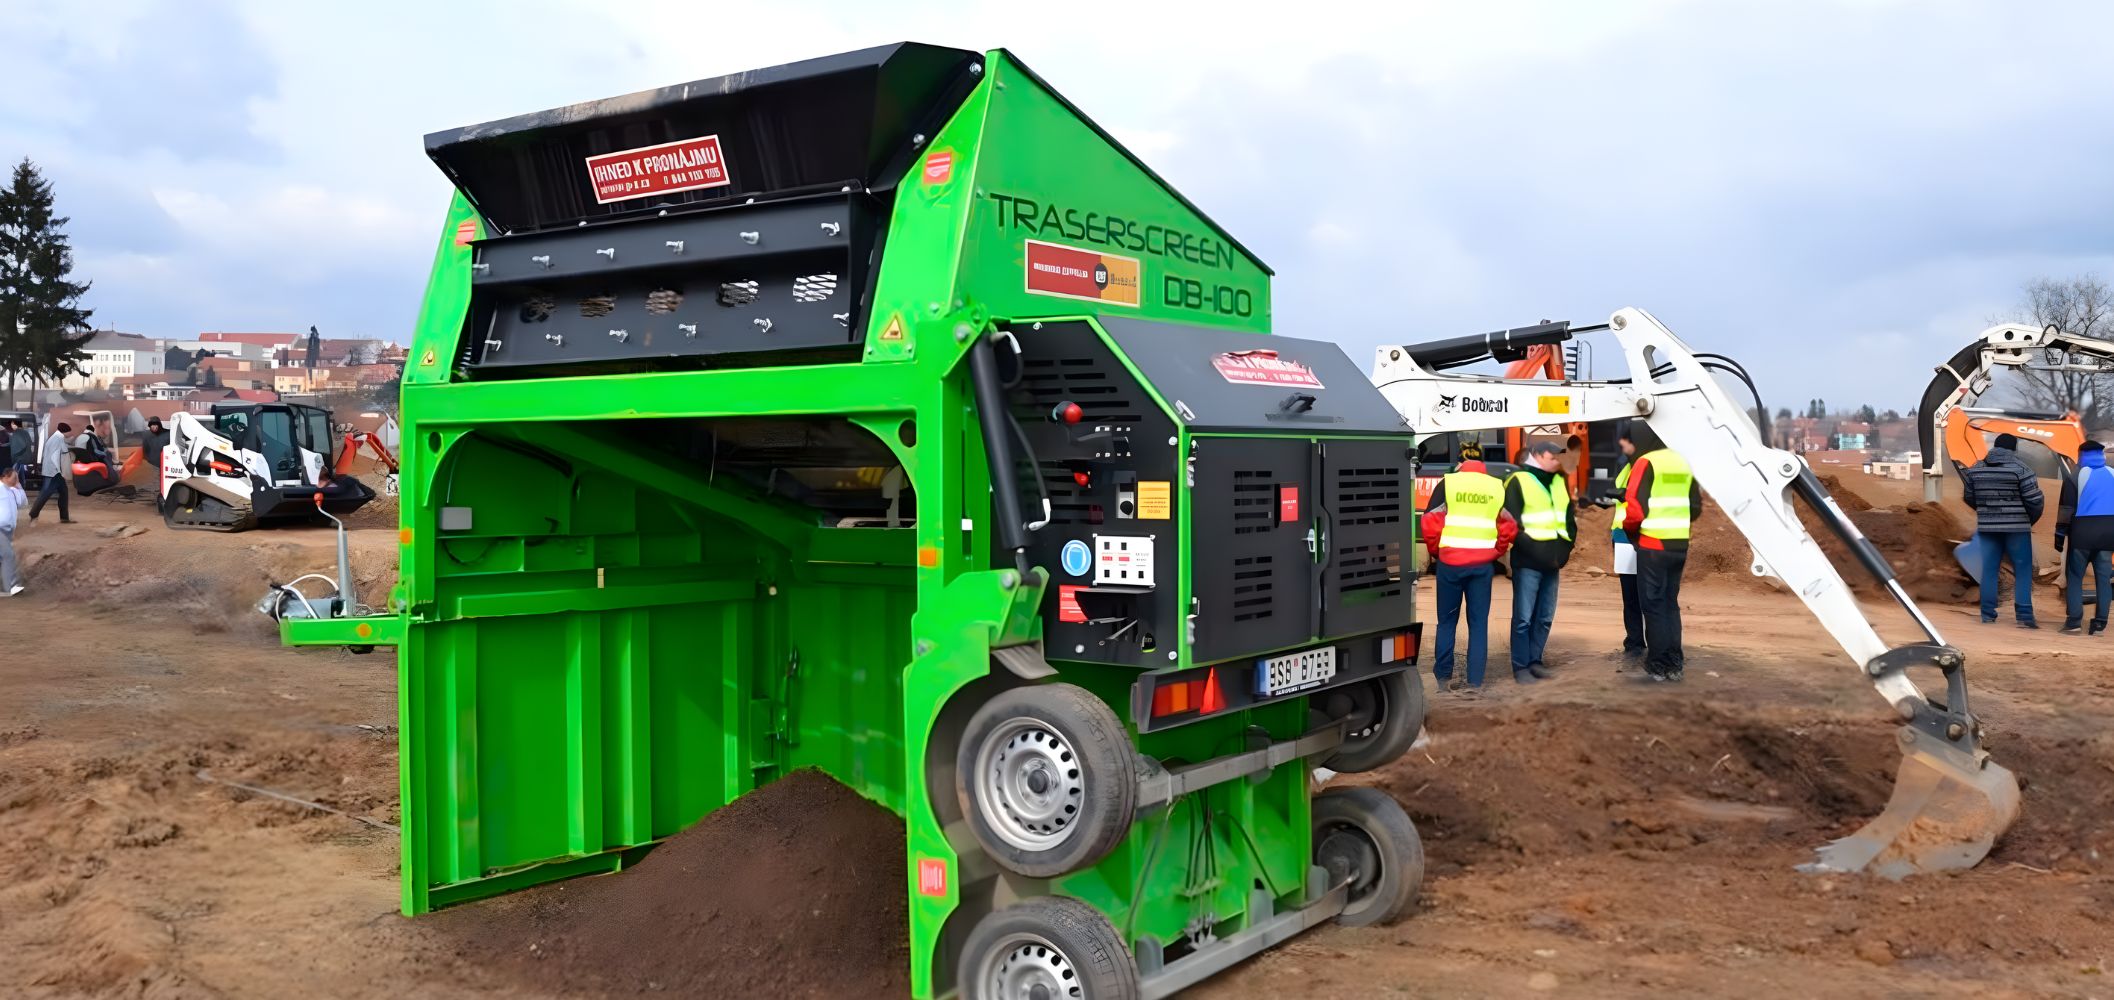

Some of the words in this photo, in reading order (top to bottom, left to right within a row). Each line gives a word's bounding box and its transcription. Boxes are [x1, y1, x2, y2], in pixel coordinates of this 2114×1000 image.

[990, 193, 1234, 271] TRASERSCREEN
[1164, 275, 1253, 317] DB-100
[1462, 397, 1509, 413] Bobcat
